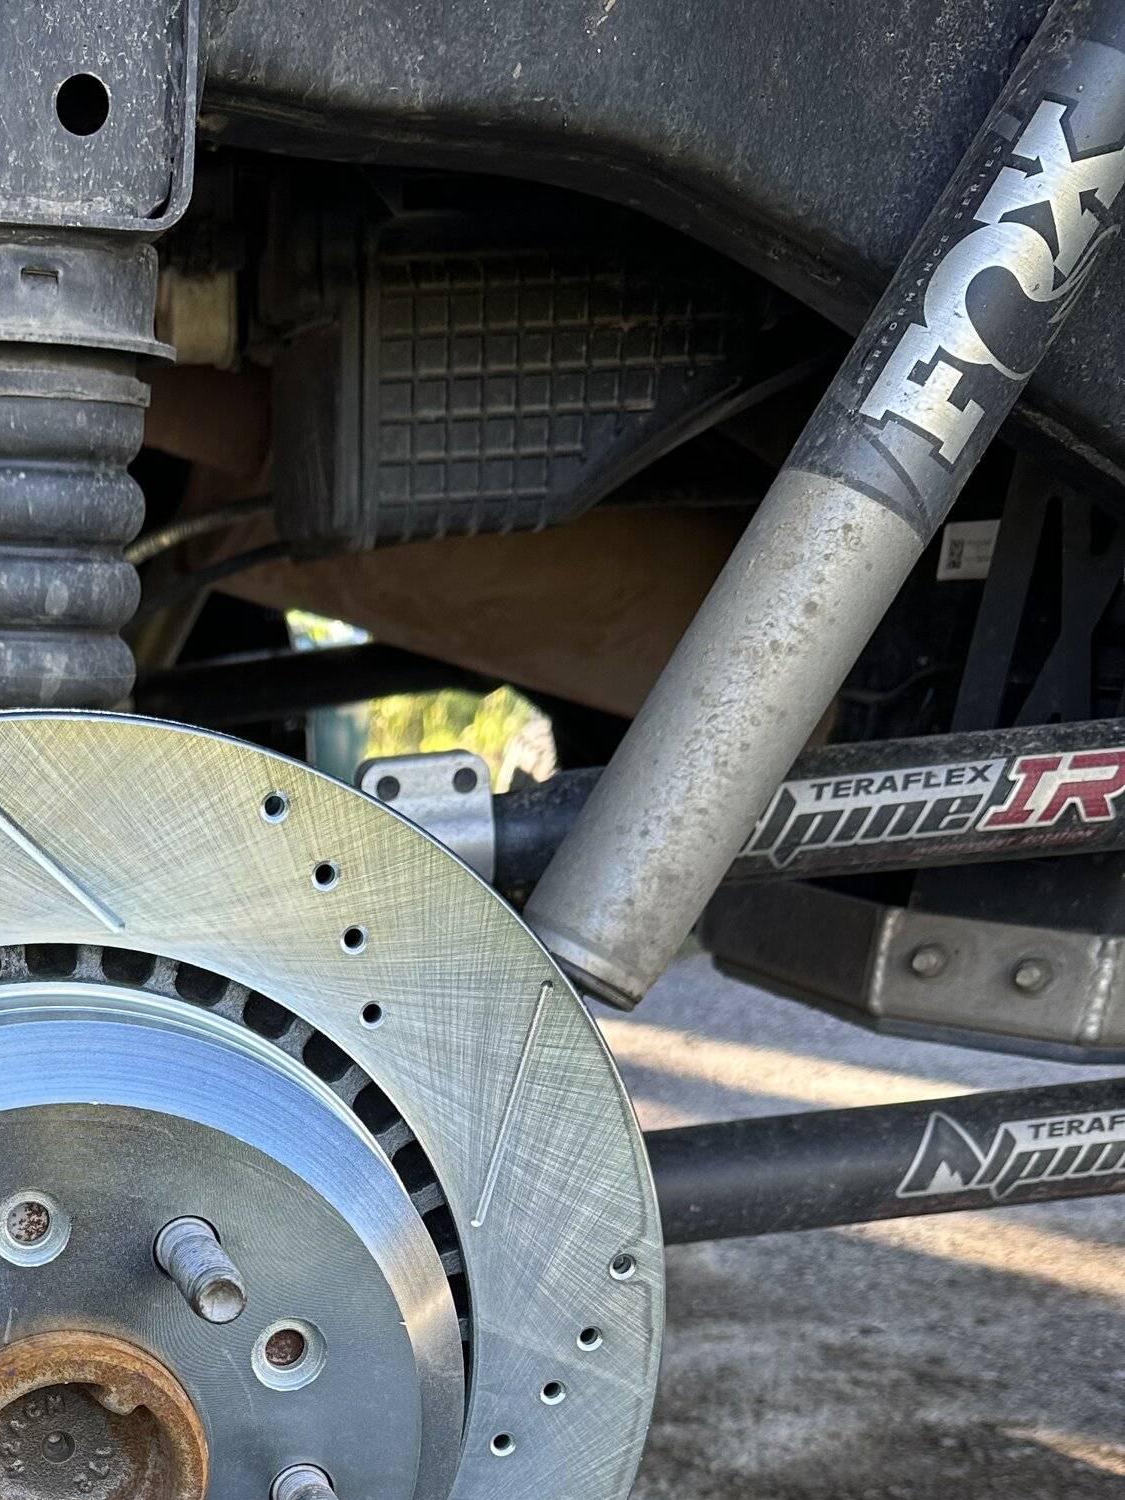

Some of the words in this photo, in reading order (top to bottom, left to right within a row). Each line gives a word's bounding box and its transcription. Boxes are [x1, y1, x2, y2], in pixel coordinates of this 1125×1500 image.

[954, 146, 1003, 220] SERIES
[859, 99, 1125, 465] FOX
[809, 763, 994, 801] TERAFLEX
